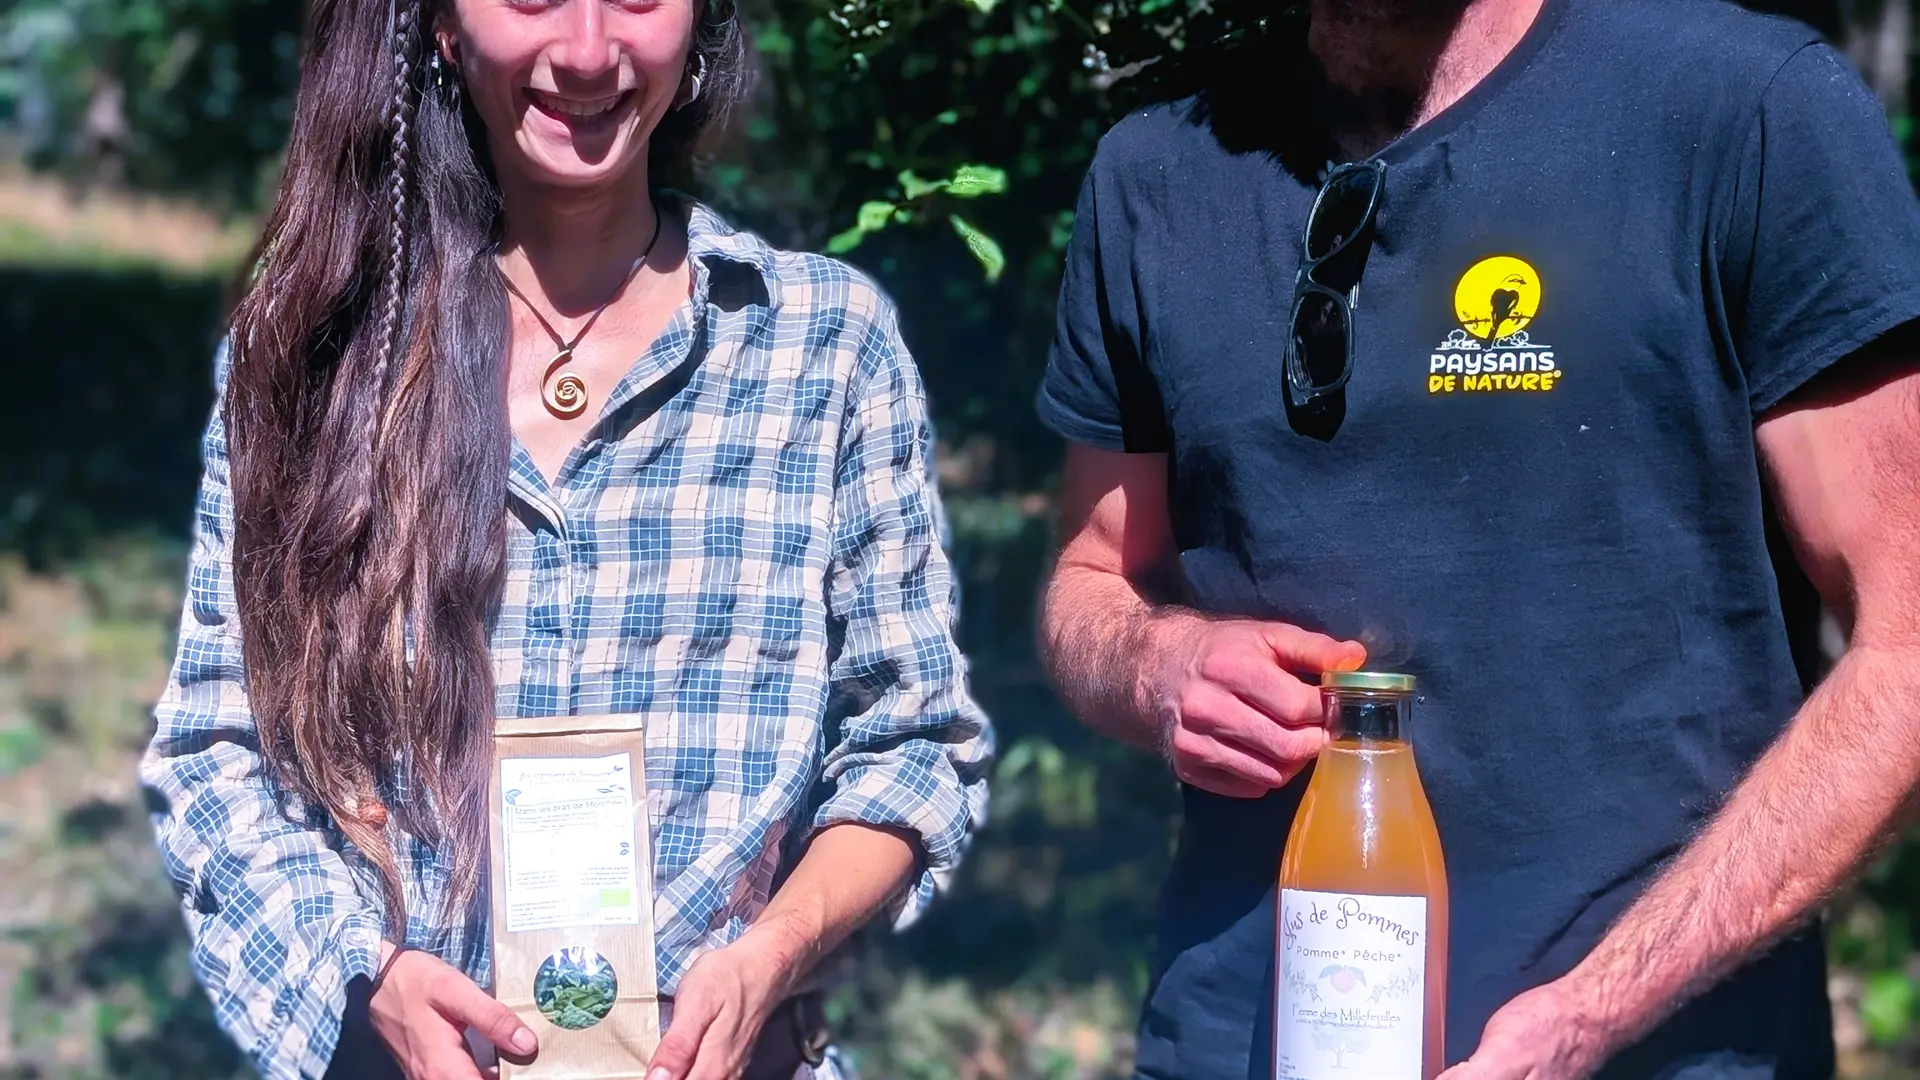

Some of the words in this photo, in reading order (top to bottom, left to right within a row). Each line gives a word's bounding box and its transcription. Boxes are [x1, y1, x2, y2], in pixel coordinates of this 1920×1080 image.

[1430, 352, 1555, 375] PAYSANS
[1429, 374, 1456, 393] DE
[1309, 901, 1328, 924] de
[1336, 897, 1419, 946] Pommes
